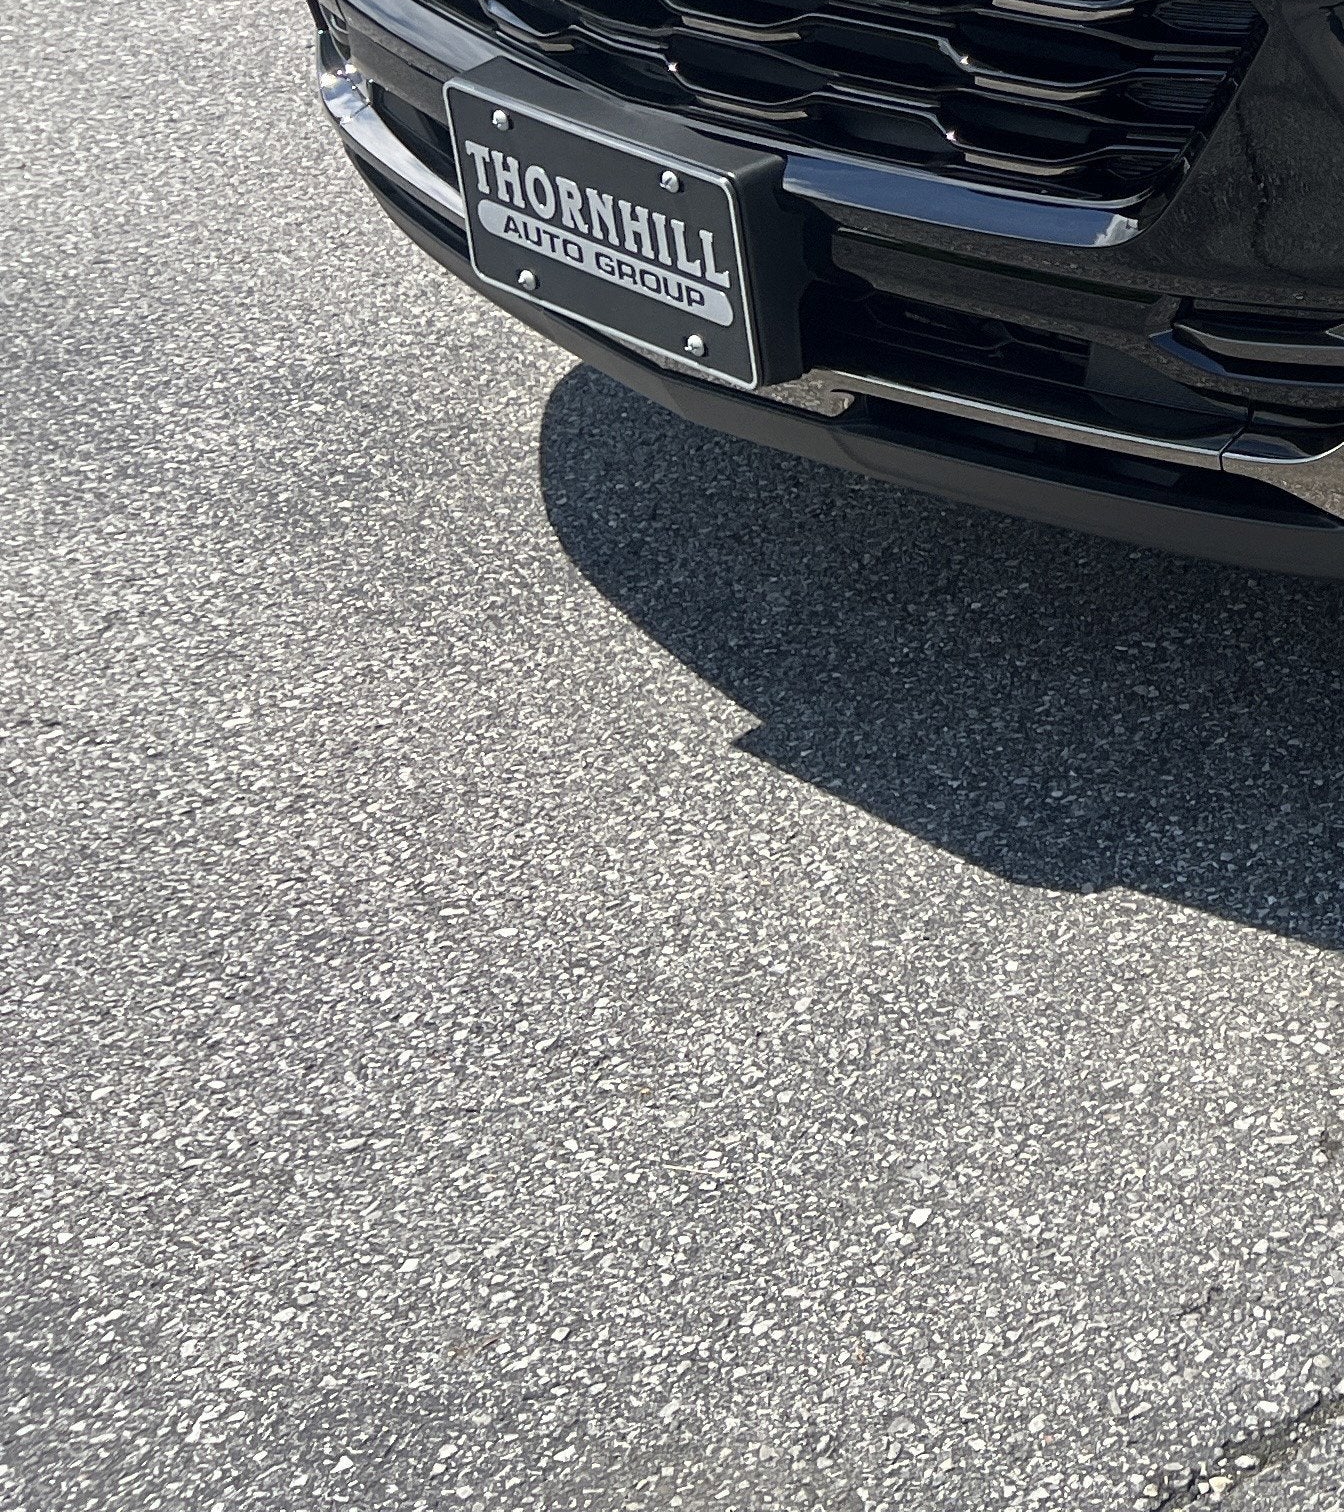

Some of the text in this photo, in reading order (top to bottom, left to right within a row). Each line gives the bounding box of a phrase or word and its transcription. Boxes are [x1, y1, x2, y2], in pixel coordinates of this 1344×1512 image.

[465, 140, 731, 289] THORNHILL
[503, 215, 705, 308] AUTO GROUP
